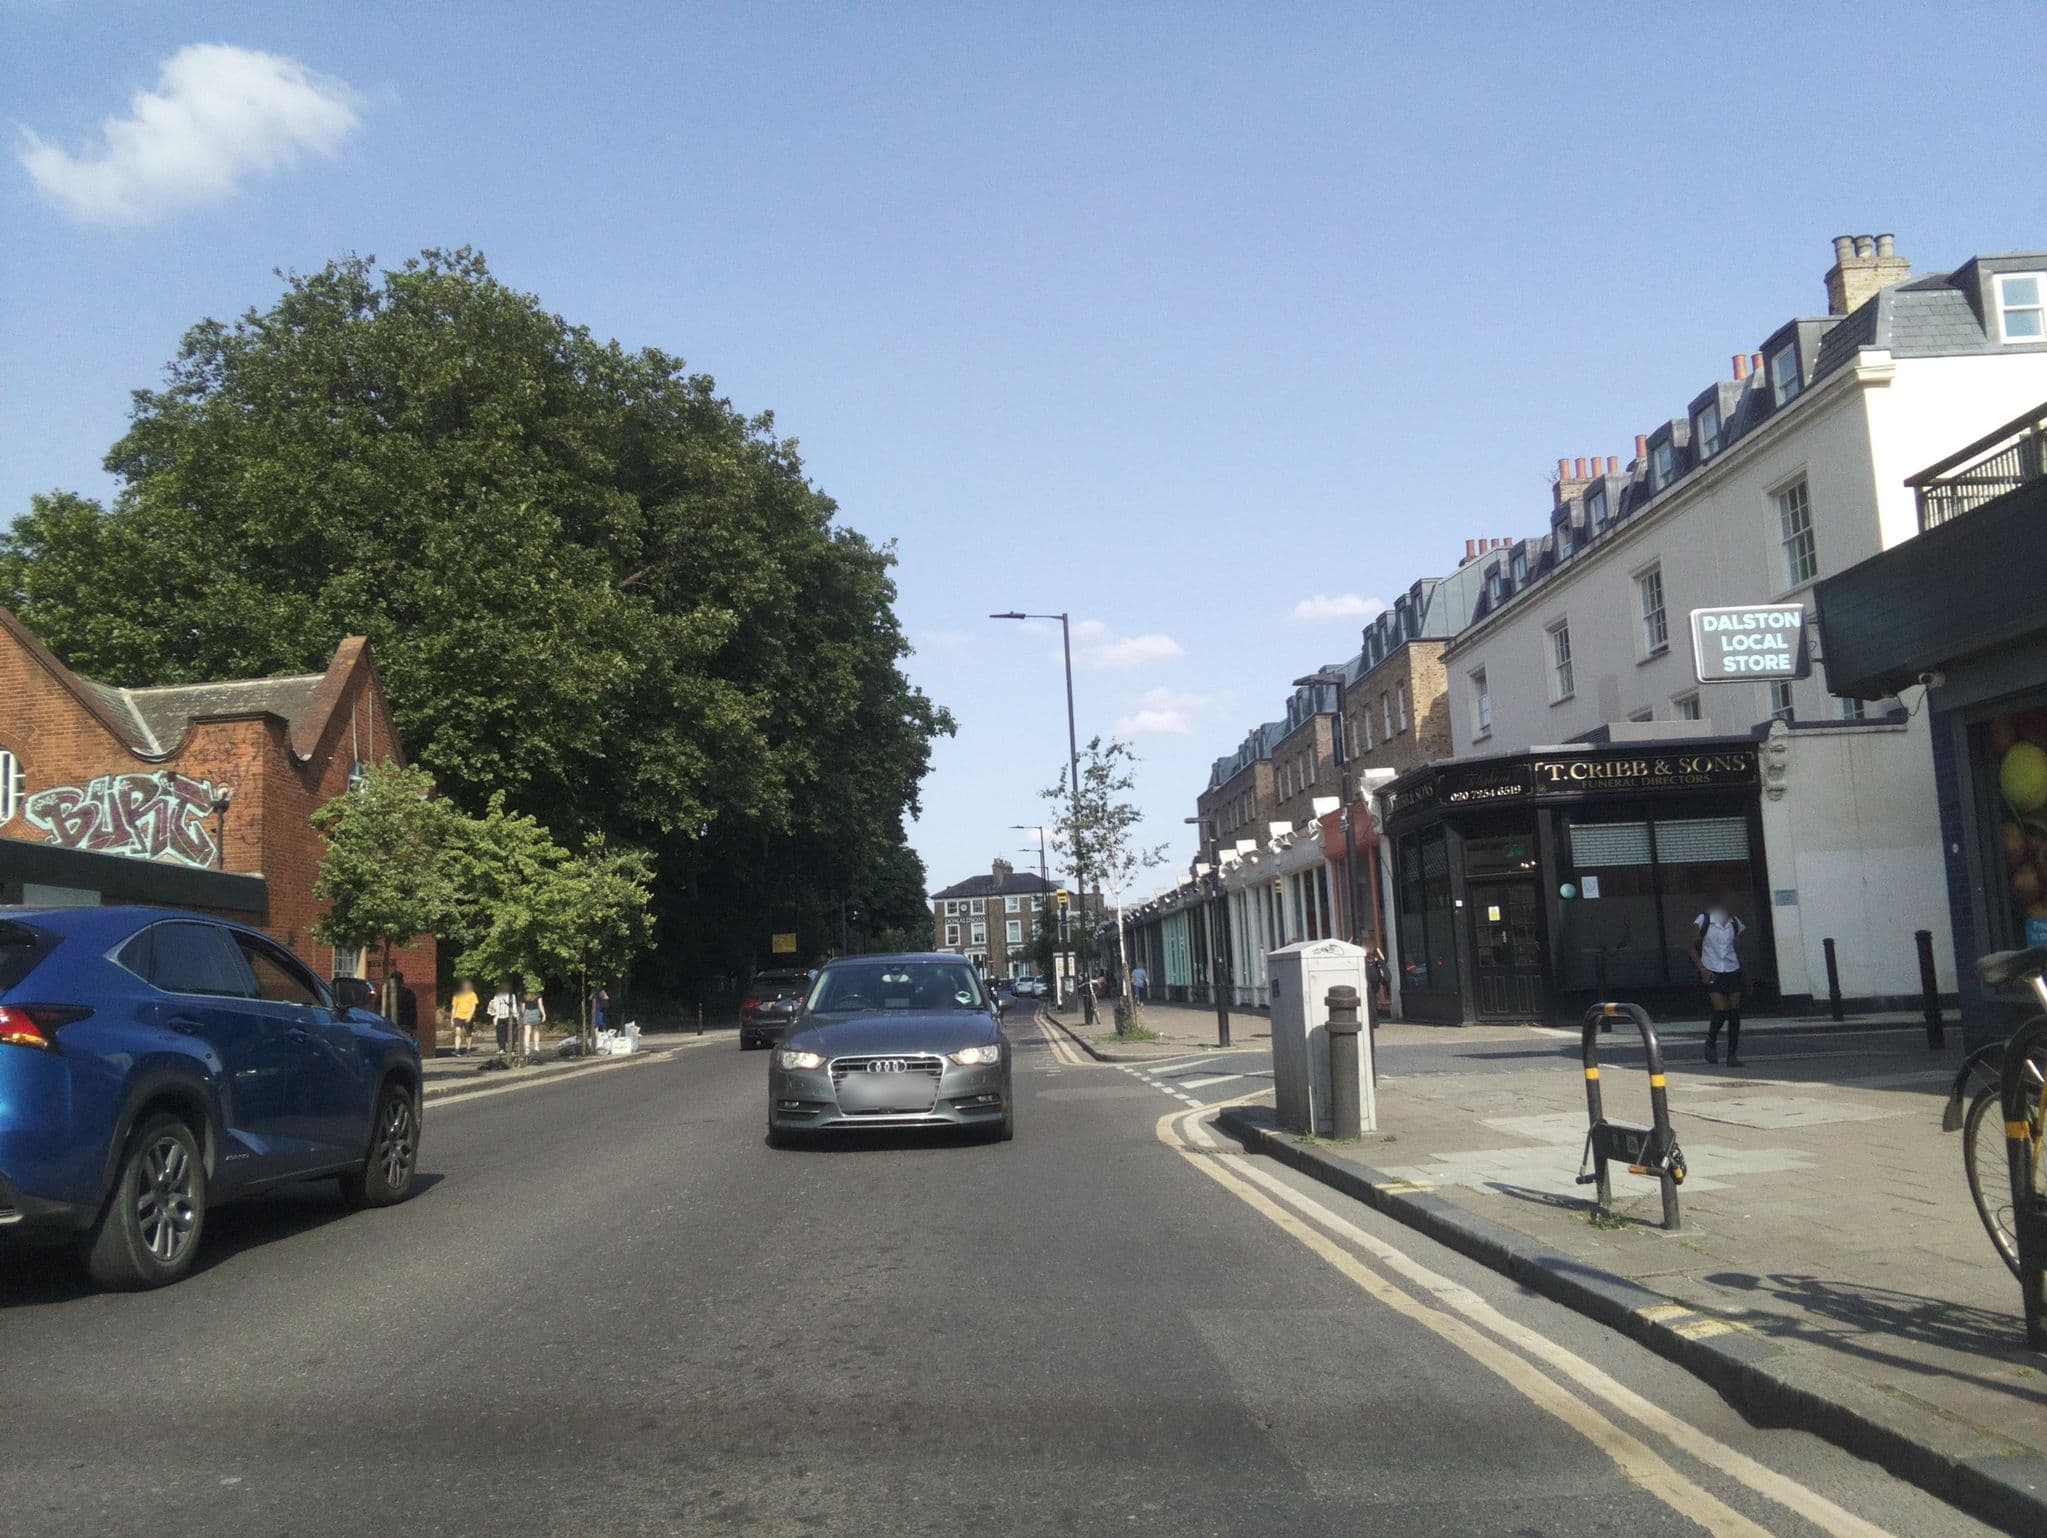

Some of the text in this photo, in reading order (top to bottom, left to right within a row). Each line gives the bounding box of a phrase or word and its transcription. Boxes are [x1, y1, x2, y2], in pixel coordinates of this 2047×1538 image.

[1703, 612, 1800, 631] DALSTON
[1721, 633, 1788, 651] LOCAL
[1723, 654, 1791, 672] STORE
[1654, 759, 1673, 776] &
[1679, 754, 1747, 775] SONS
[1581, 774, 1712, 790] FUNERAL DIRECTORS
[1450, 791, 1470, 802] 020
[1497, 784, 1522, 796] 6519
